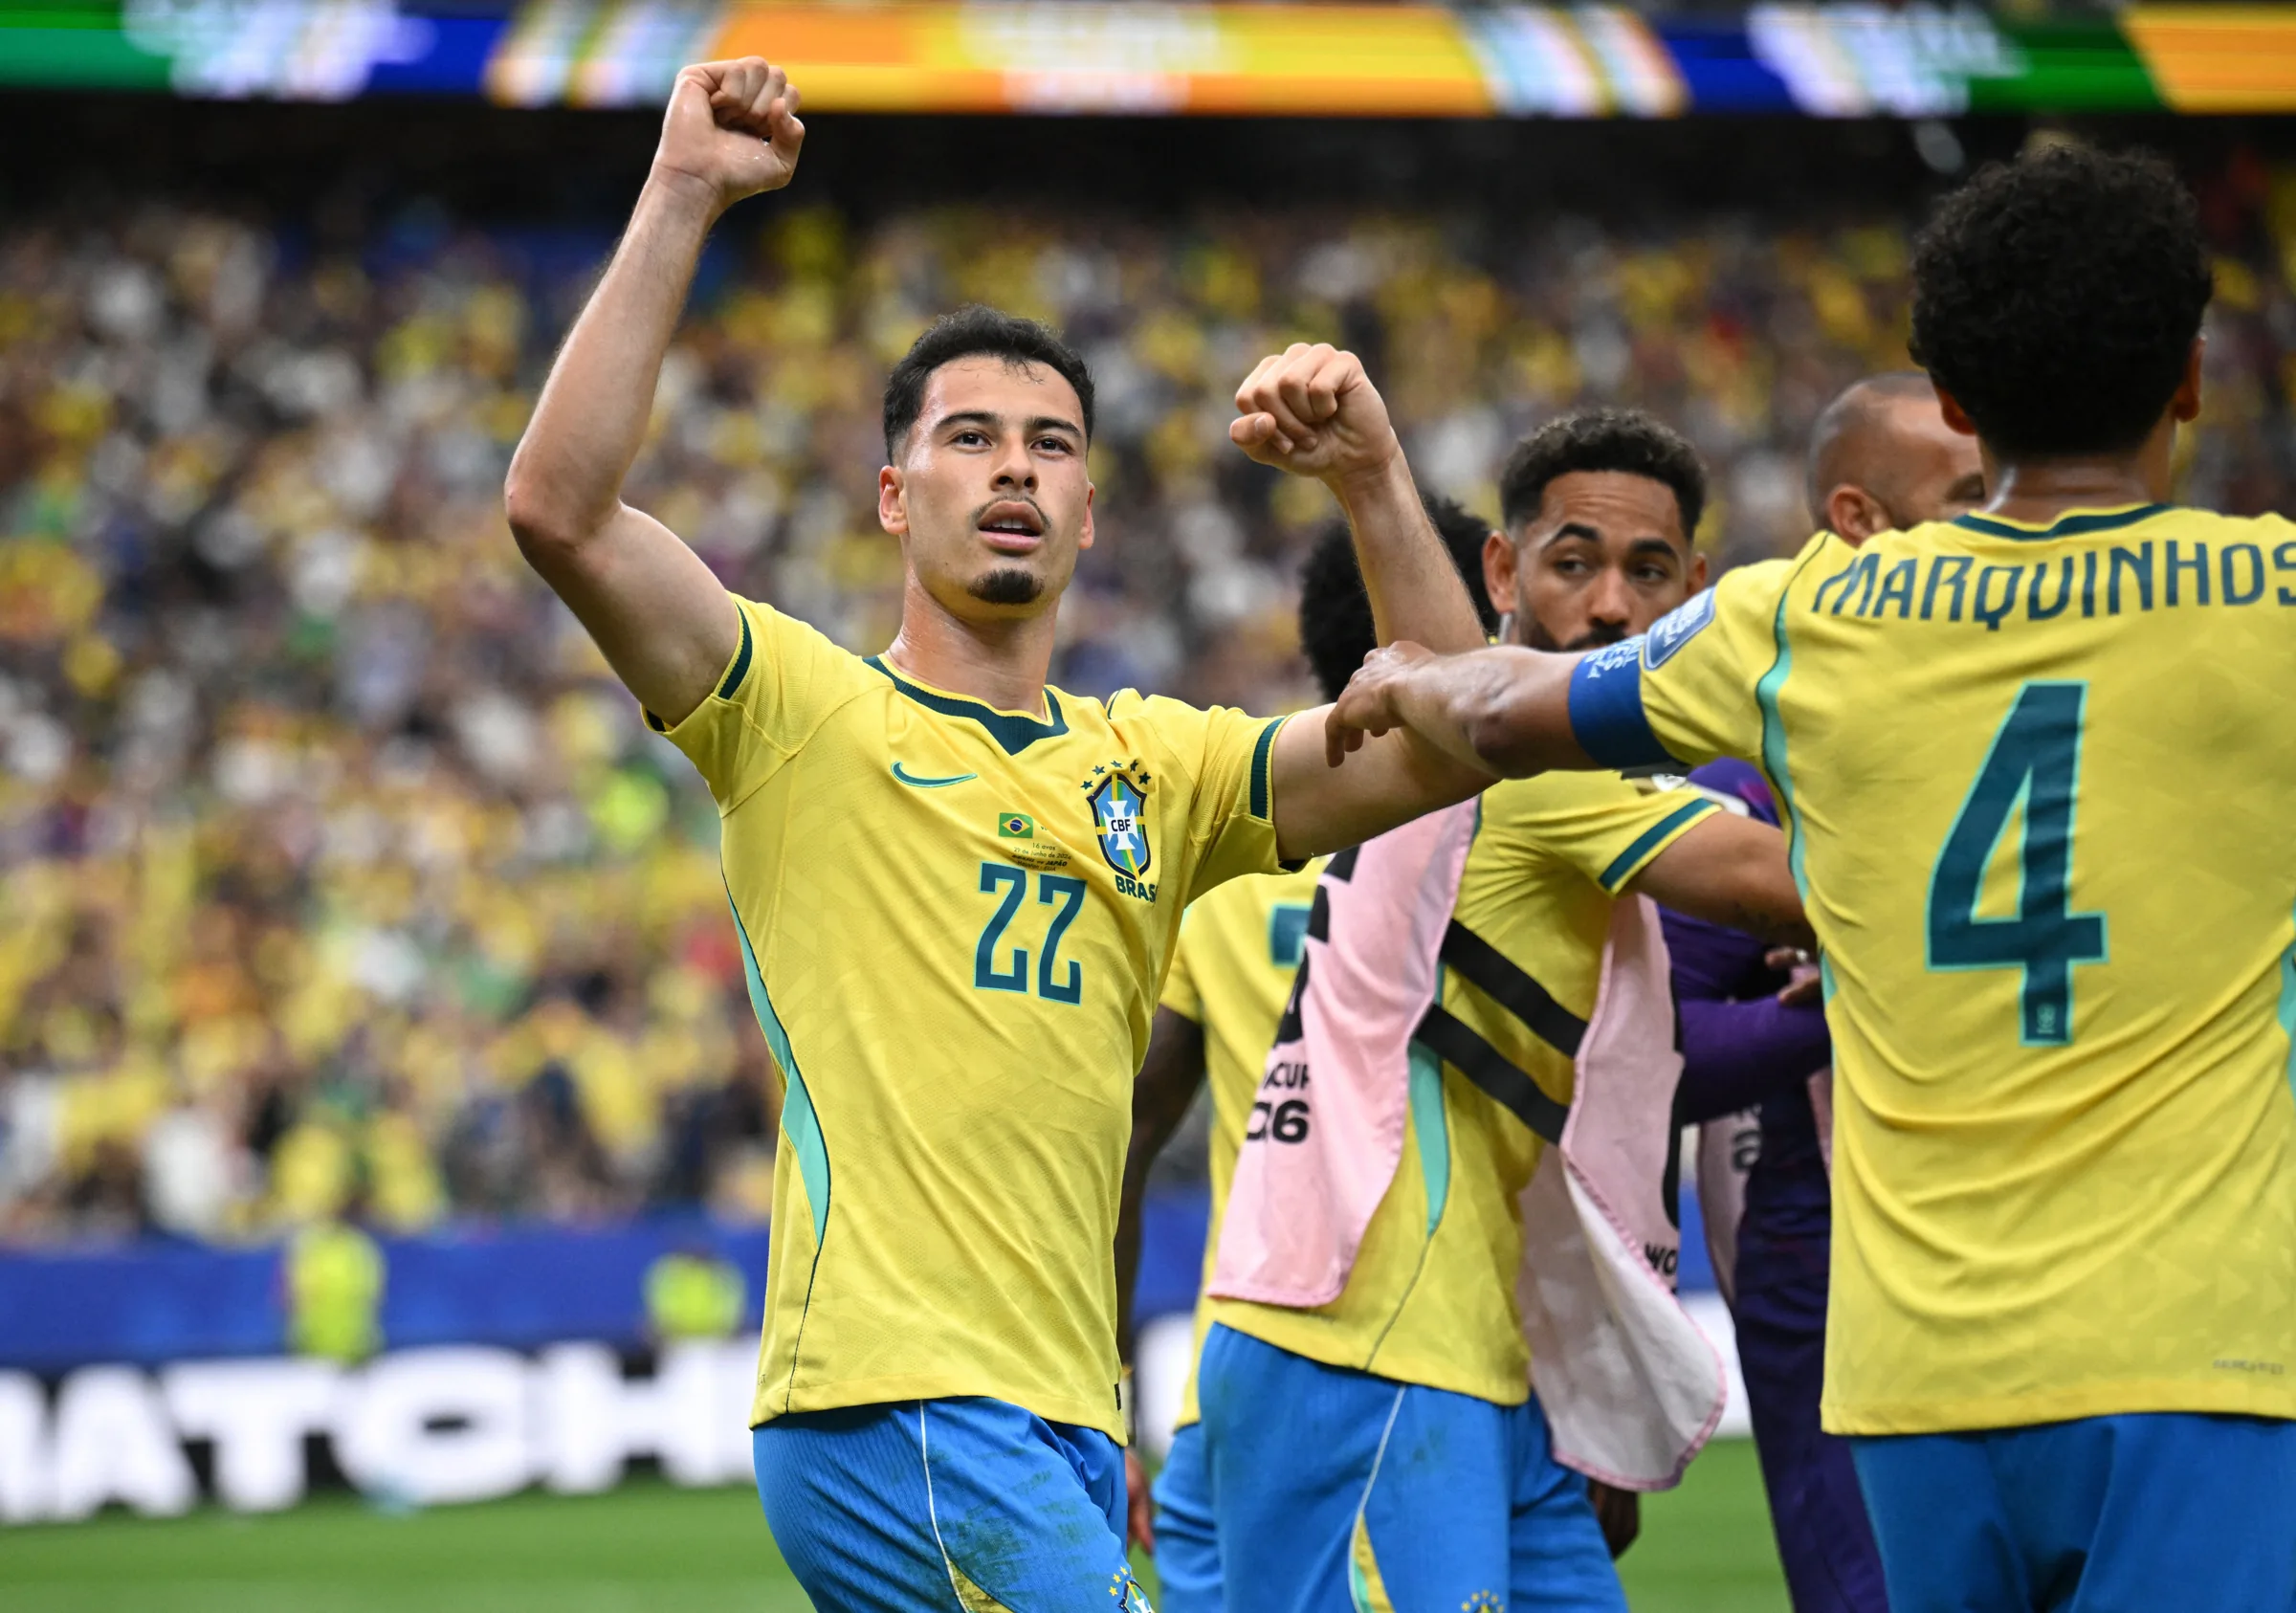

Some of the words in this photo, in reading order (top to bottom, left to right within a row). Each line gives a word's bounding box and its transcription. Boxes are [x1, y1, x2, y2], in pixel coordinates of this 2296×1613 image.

[1812, 541, 2296, 630] MARQUINHOS
[1111, 819, 1131, 831] CBF
[1925, 680, 2108, 1046] 4
[1115, 874, 1159, 903] BRAS
[974, 861, 1089, 1006] 22
